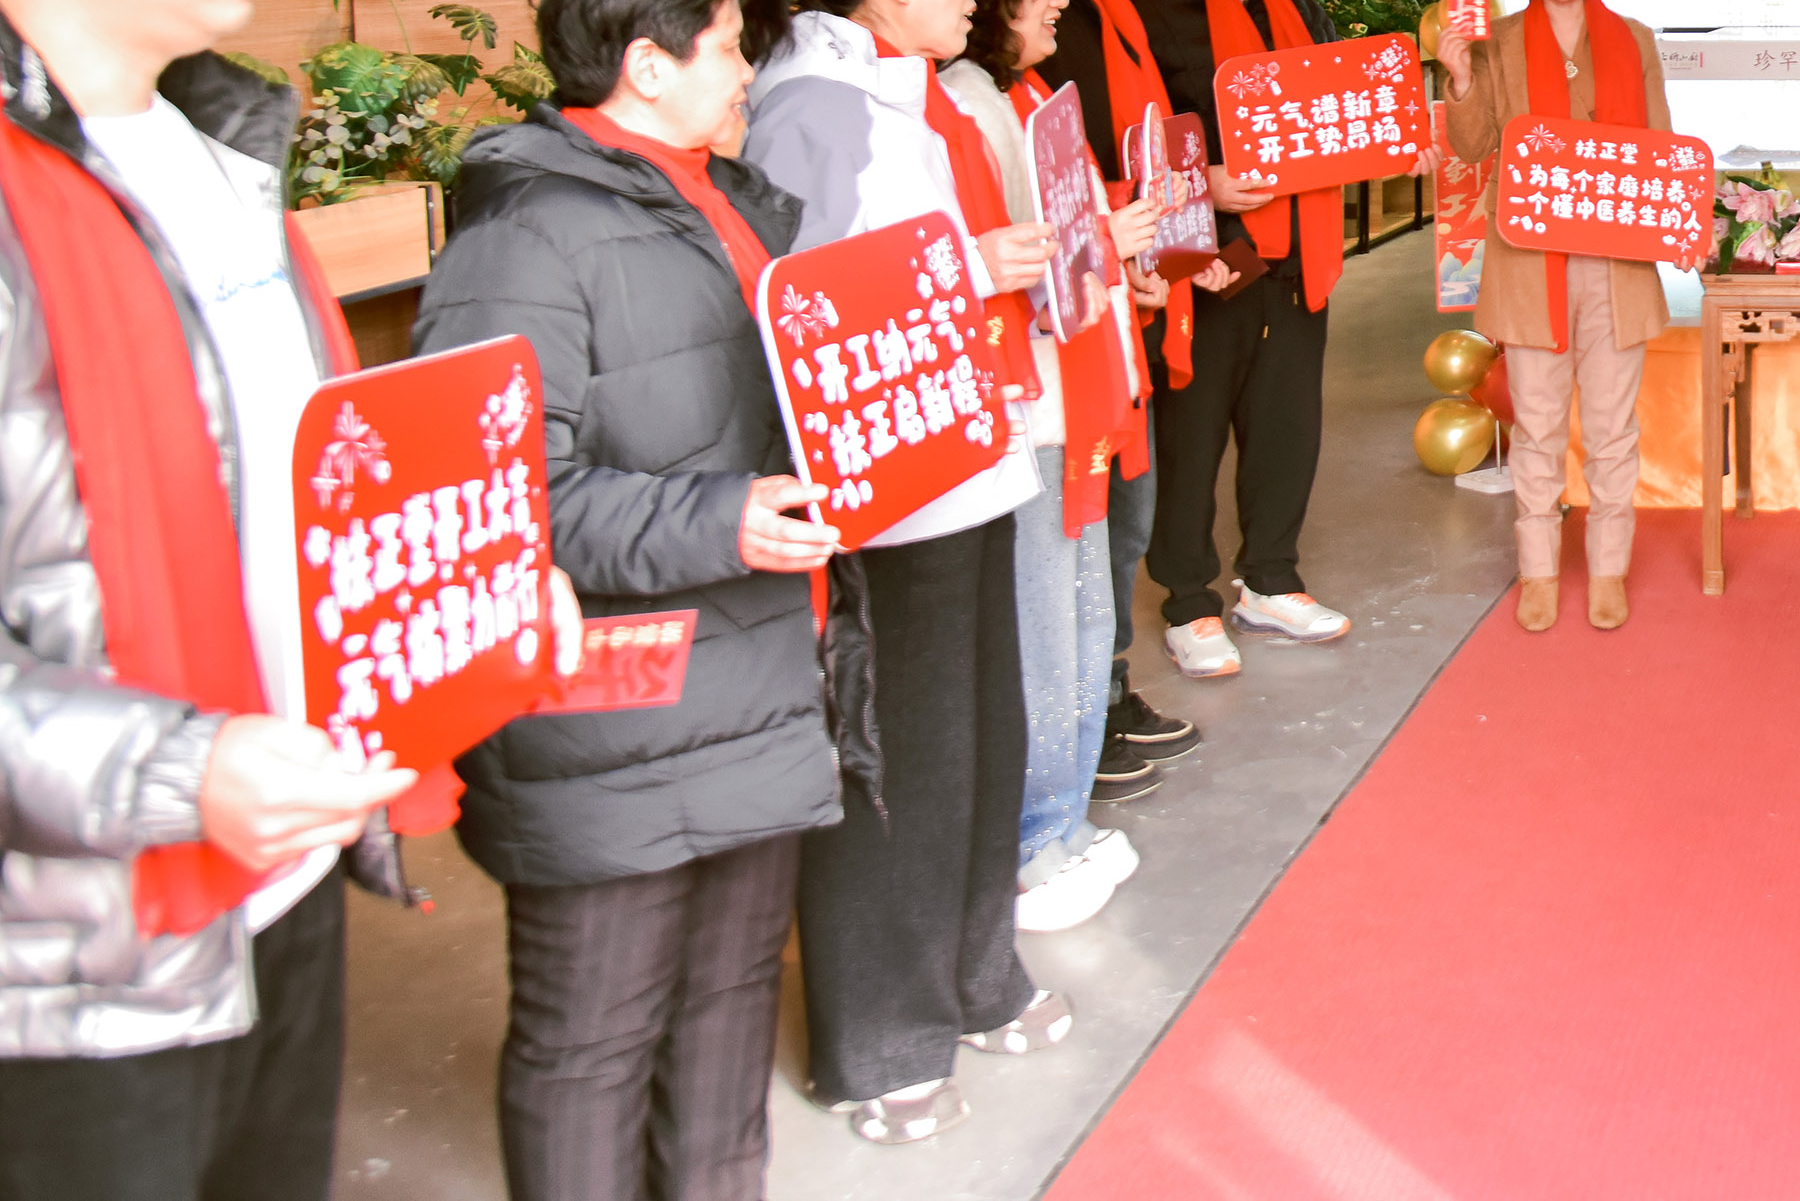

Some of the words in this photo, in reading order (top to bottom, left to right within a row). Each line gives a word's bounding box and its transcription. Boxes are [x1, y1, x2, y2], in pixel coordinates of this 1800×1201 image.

[1250, 84, 1400, 134] 元气谱新章
[1257, 115, 1402, 164] 开工势昂扬
[1574, 138, 1640, 165] 扶正堂
[1528, 162, 1687, 204] 为每个家庭培养
[1508, 190, 1703, 232] 一个懂中医养生的人
